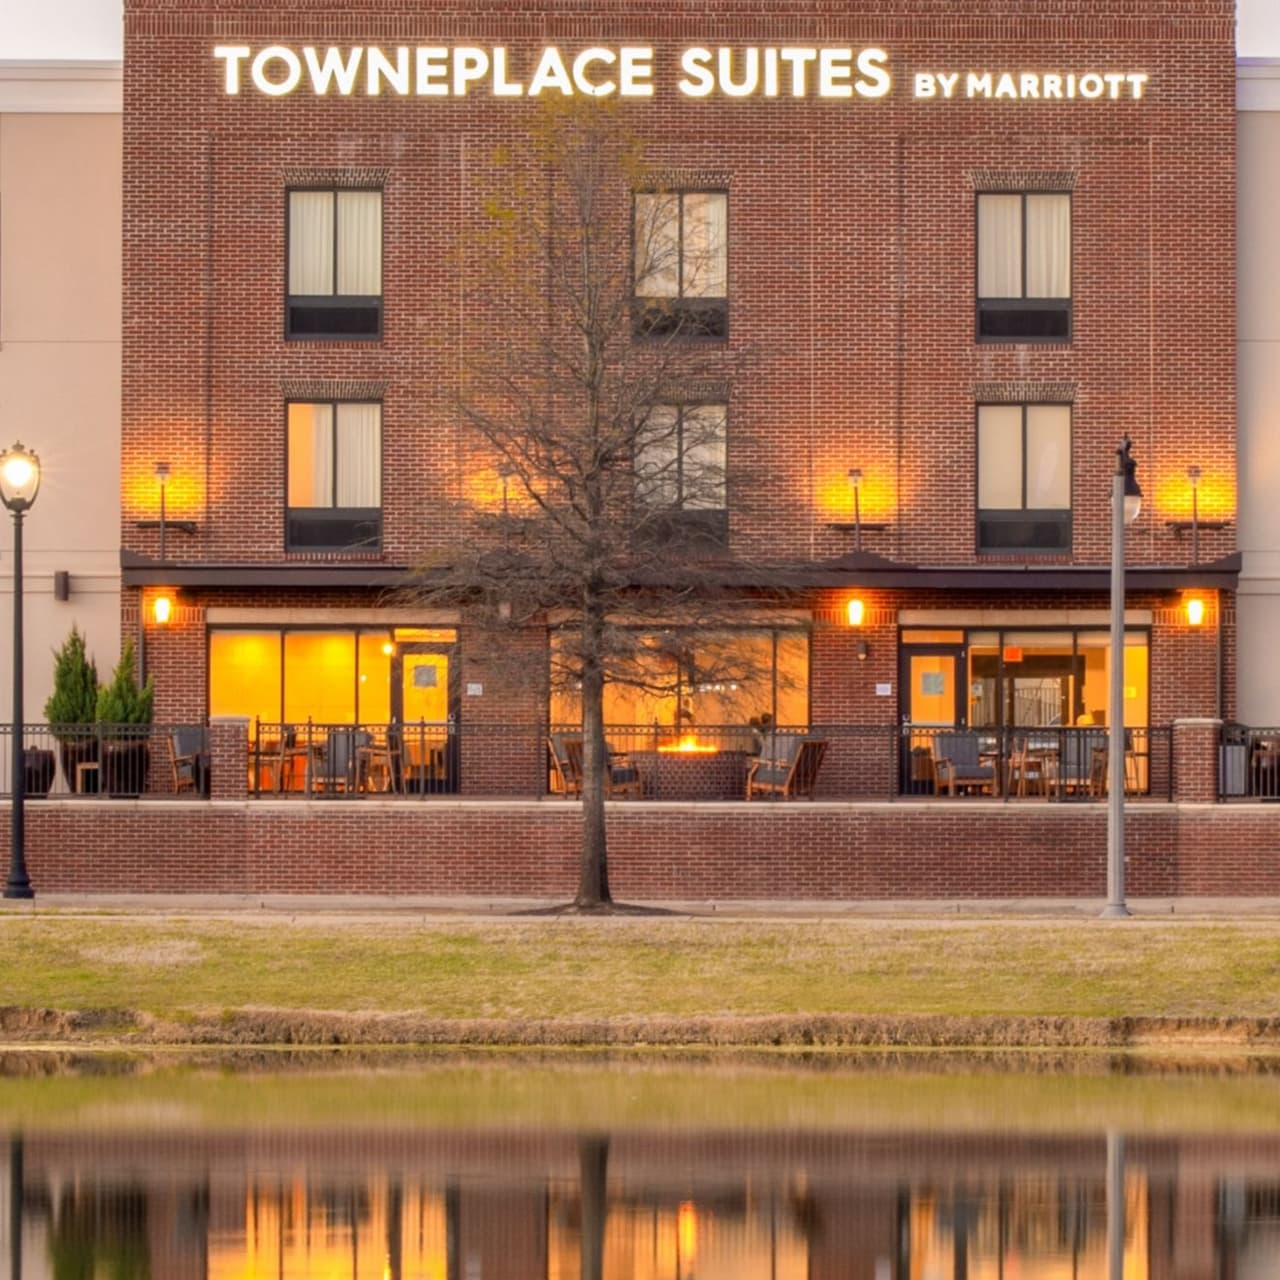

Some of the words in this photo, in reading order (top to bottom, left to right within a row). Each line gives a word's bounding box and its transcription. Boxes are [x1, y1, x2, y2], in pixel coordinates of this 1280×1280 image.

[213, 46, 653, 96] TOWNEPLACE
[677, 47, 890, 97] SUITES
[914, 73, 957, 97] BY
[966, 73, 1146, 98] MARRIOTT
